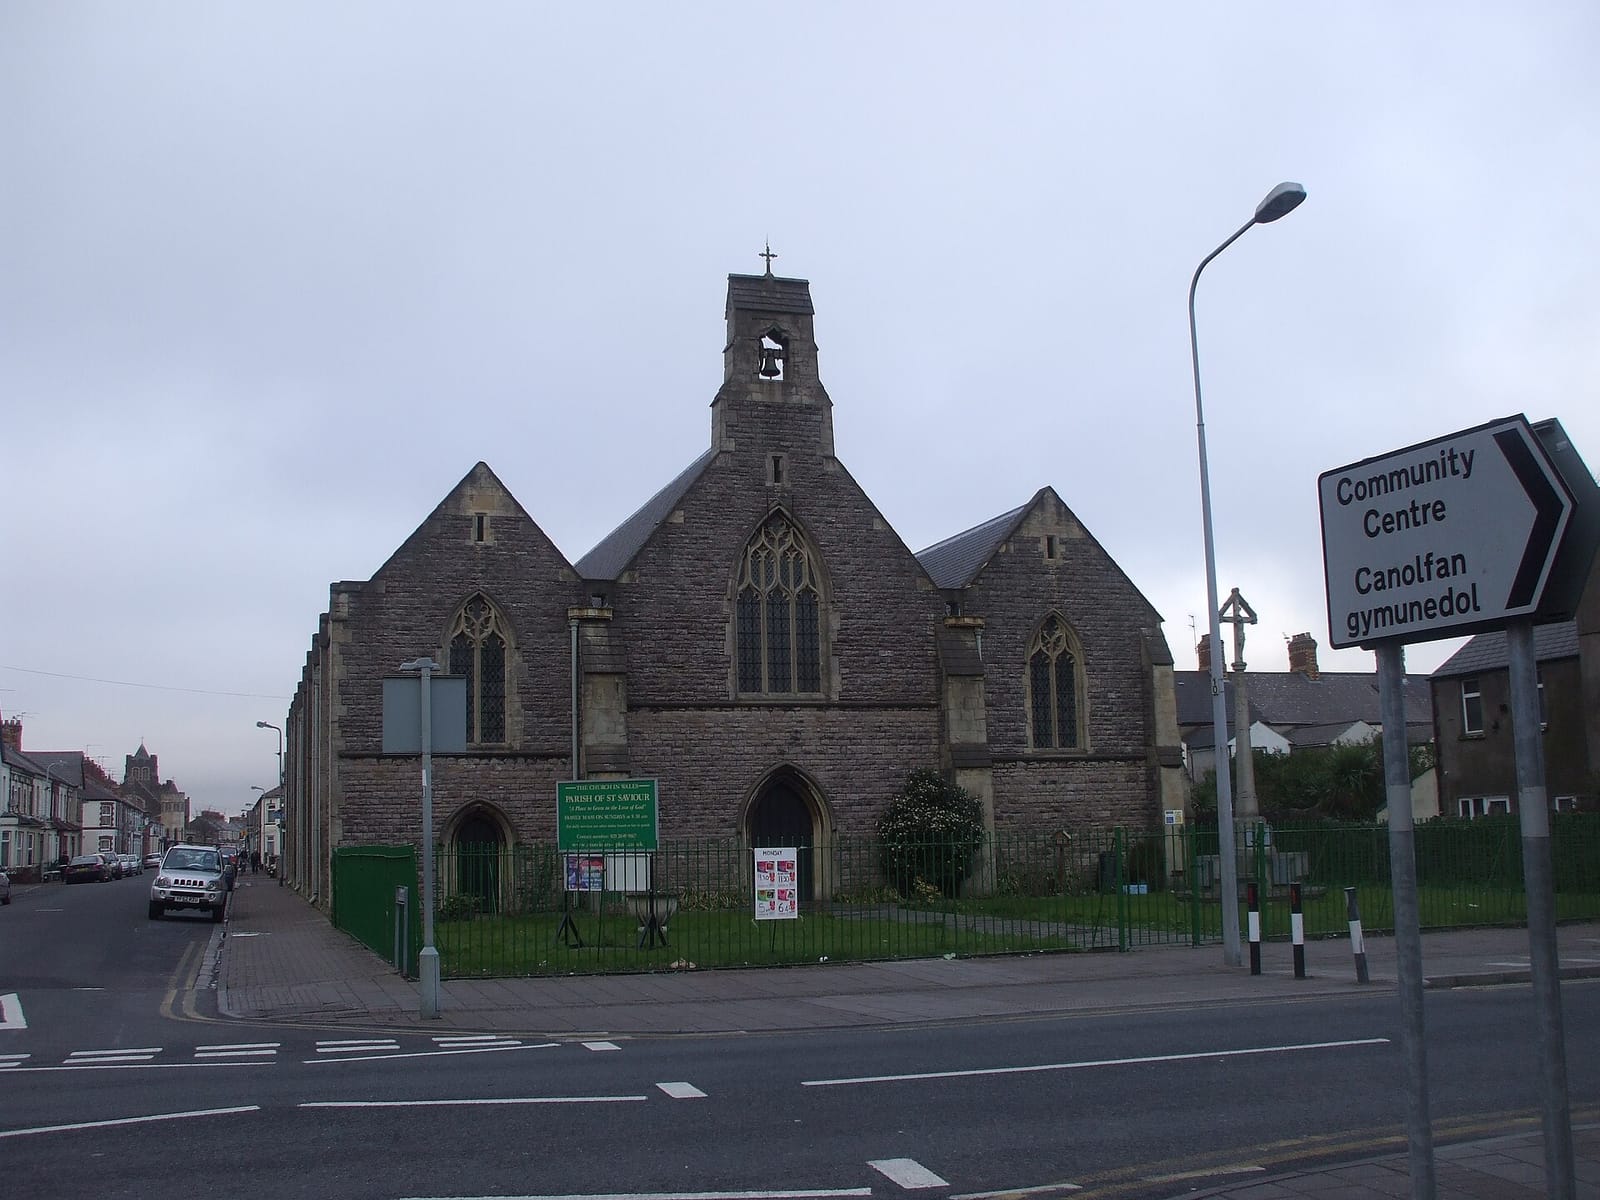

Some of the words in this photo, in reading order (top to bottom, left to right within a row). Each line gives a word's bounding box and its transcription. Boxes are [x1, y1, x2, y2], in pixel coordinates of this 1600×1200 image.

[1336, 447, 1475, 506] Community
[1363, 500, 1446, 538] Centre
[1355, 552, 1467, 595] Canolfan
[1346, 583, 1481, 638] gymunedol
[565, 794, 593, 803] PARISH
[594, 794, 605, 802] OF
[606, 794, 616, 802] ST
[617, 793, 650, 801] SAVIOUR
